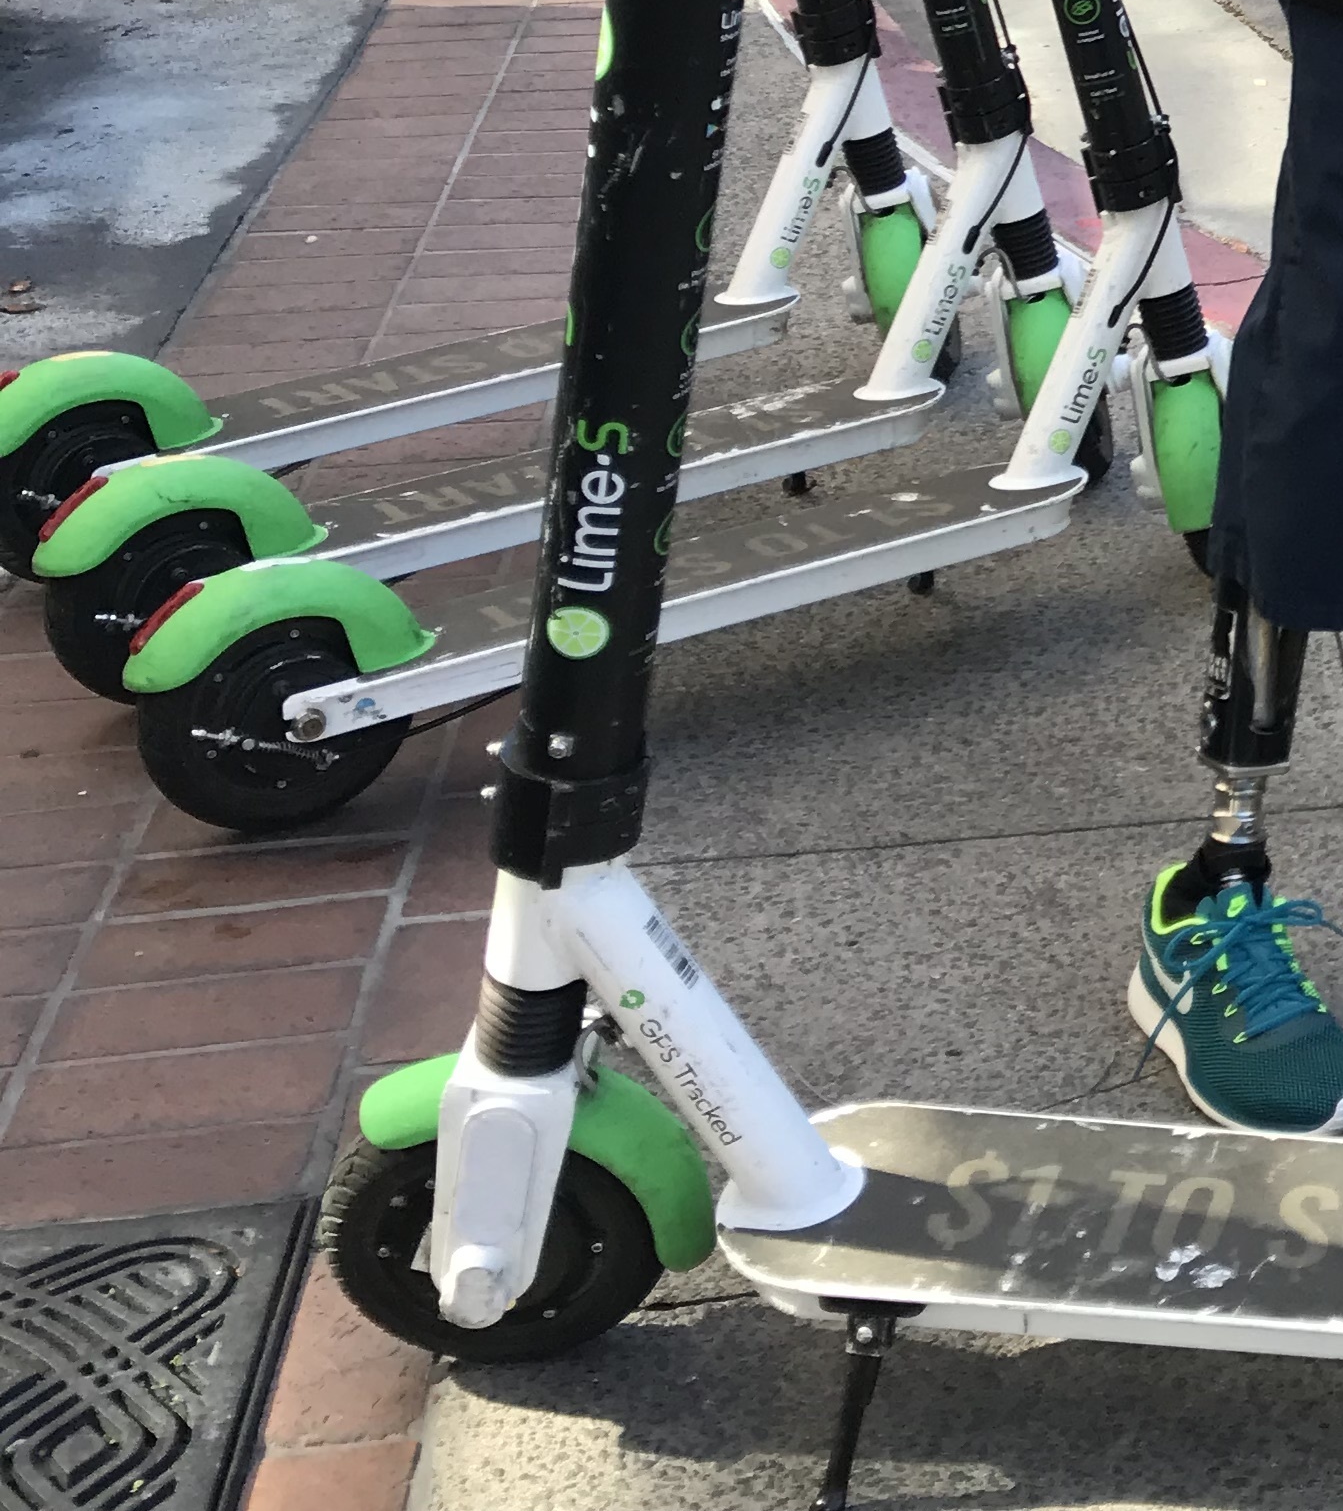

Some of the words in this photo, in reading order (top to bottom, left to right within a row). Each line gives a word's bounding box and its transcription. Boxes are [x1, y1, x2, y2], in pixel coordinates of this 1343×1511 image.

[639, 1018, 681, 1063] GPS
[674, 1062, 742, 1147] Tracked
[1100, 1170, 1235, 1258] TO
